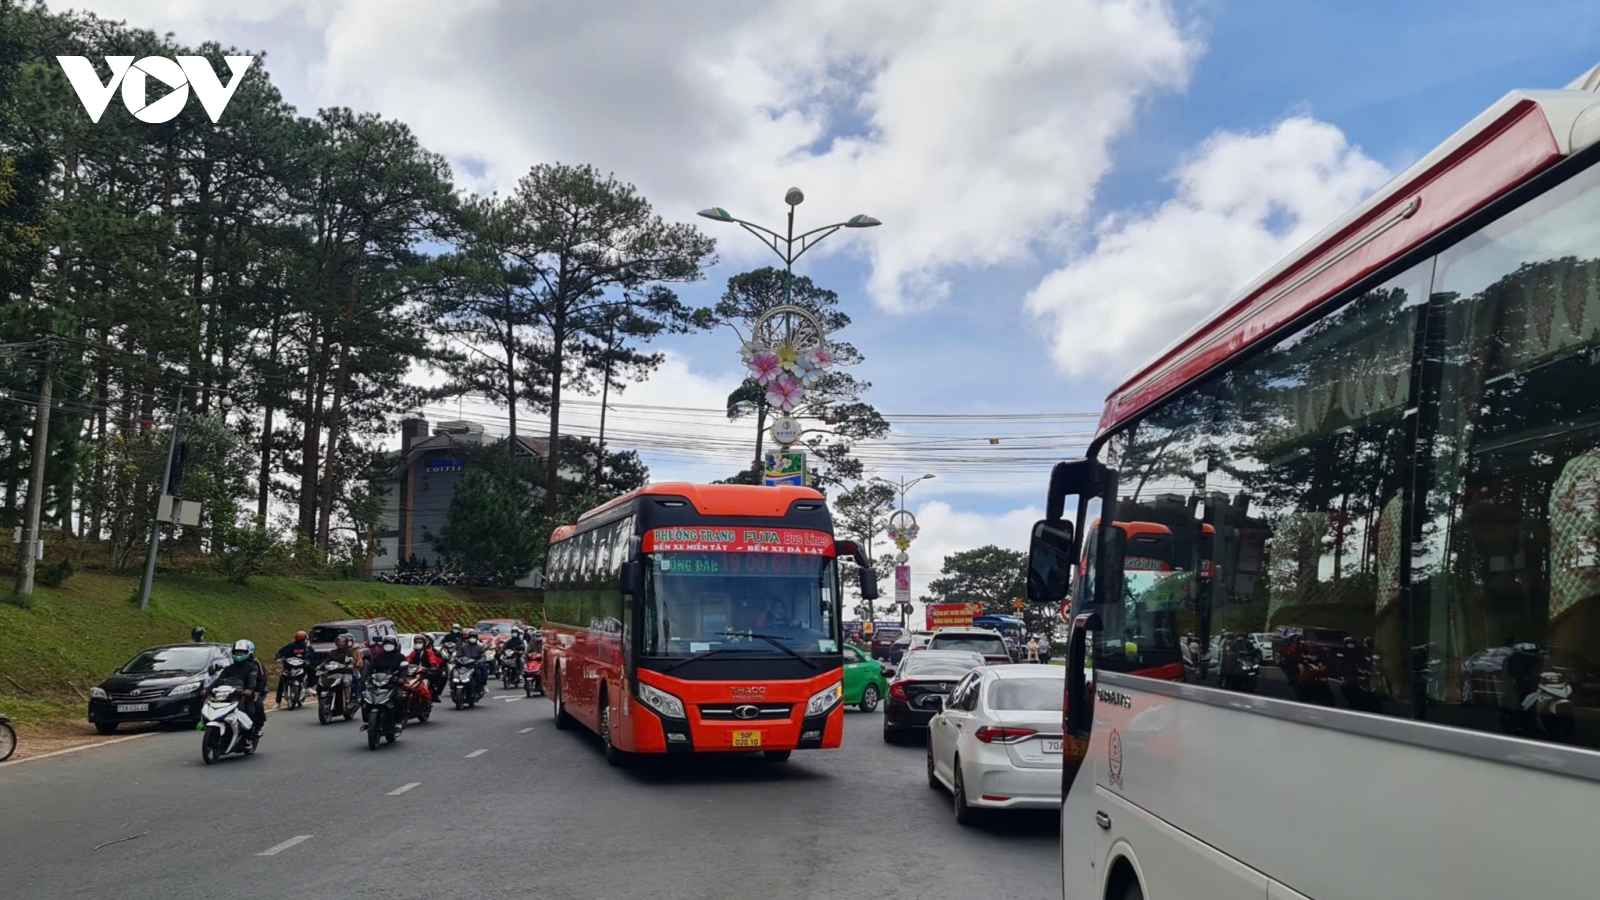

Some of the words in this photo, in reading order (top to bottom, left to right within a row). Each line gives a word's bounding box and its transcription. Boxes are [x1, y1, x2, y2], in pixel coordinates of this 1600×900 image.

[700, 529, 736, 542] TRANG
[743, 530, 781, 544] FUTA
[784, 532, 803, 545] Bus
[804, 532, 830, 547] Lines
[710, 543, 728, 551] TÂY
[804, 547, 824, 555] LẠT
[730, 686, 766, 694] THACO
